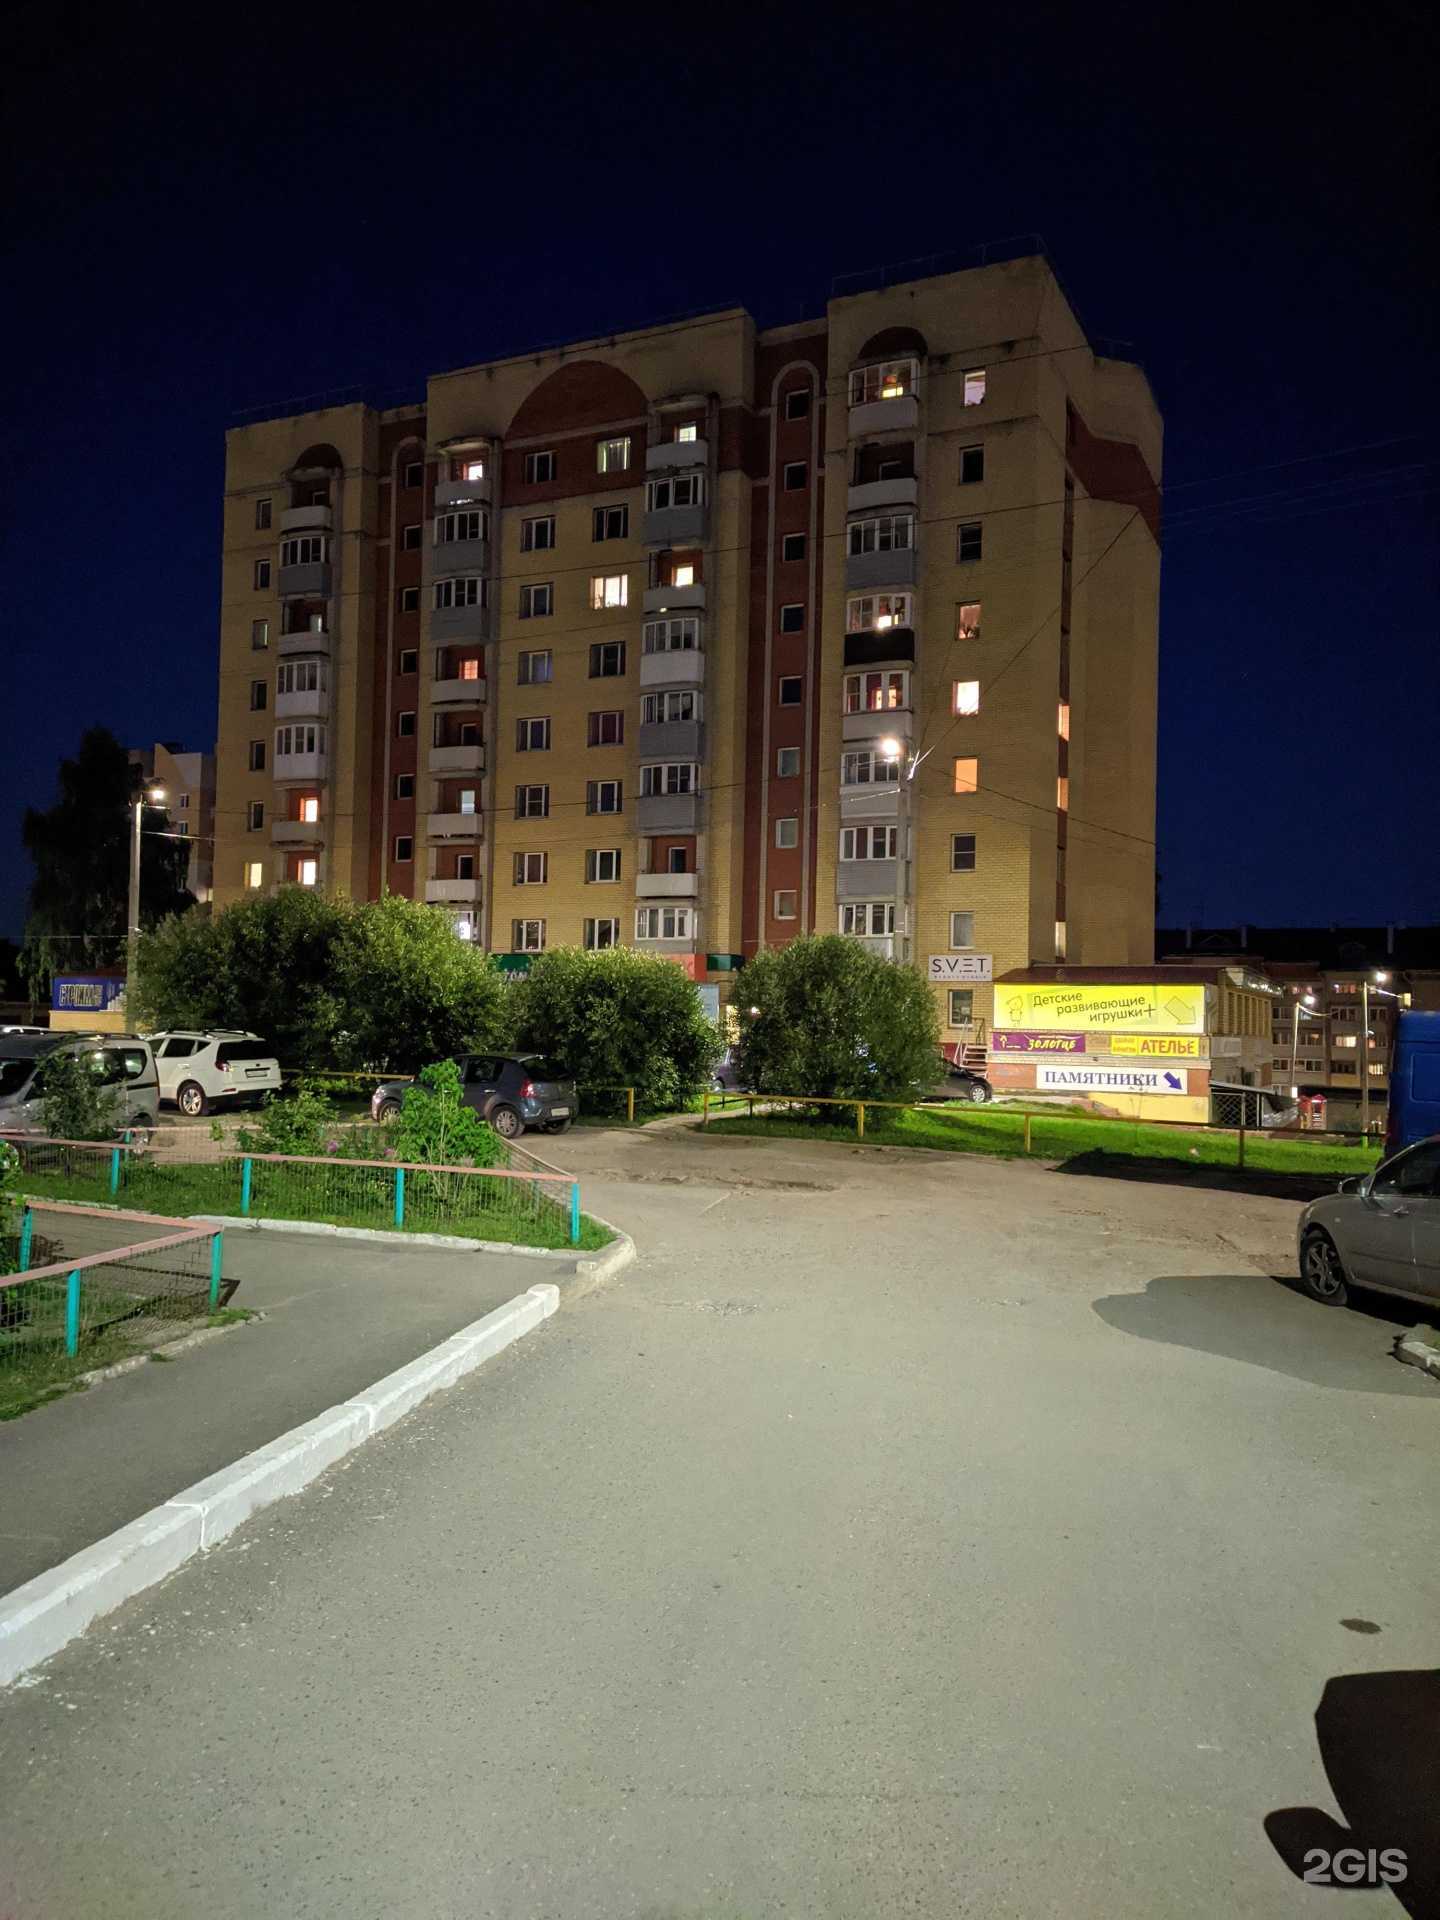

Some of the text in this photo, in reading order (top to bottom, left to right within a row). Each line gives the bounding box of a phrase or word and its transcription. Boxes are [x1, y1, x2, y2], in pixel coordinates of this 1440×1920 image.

[932, 958, 990, 973] S.V.E.T.
[1033, 992, 1083, 1008] Детские
[1056, 996, 1146, 1016] развивающие
[1140, 1039, 1195, 1054] АТЕЛЬЕ
[1044, 1071, 1158, 1087] ПАМЯТНИКИ
